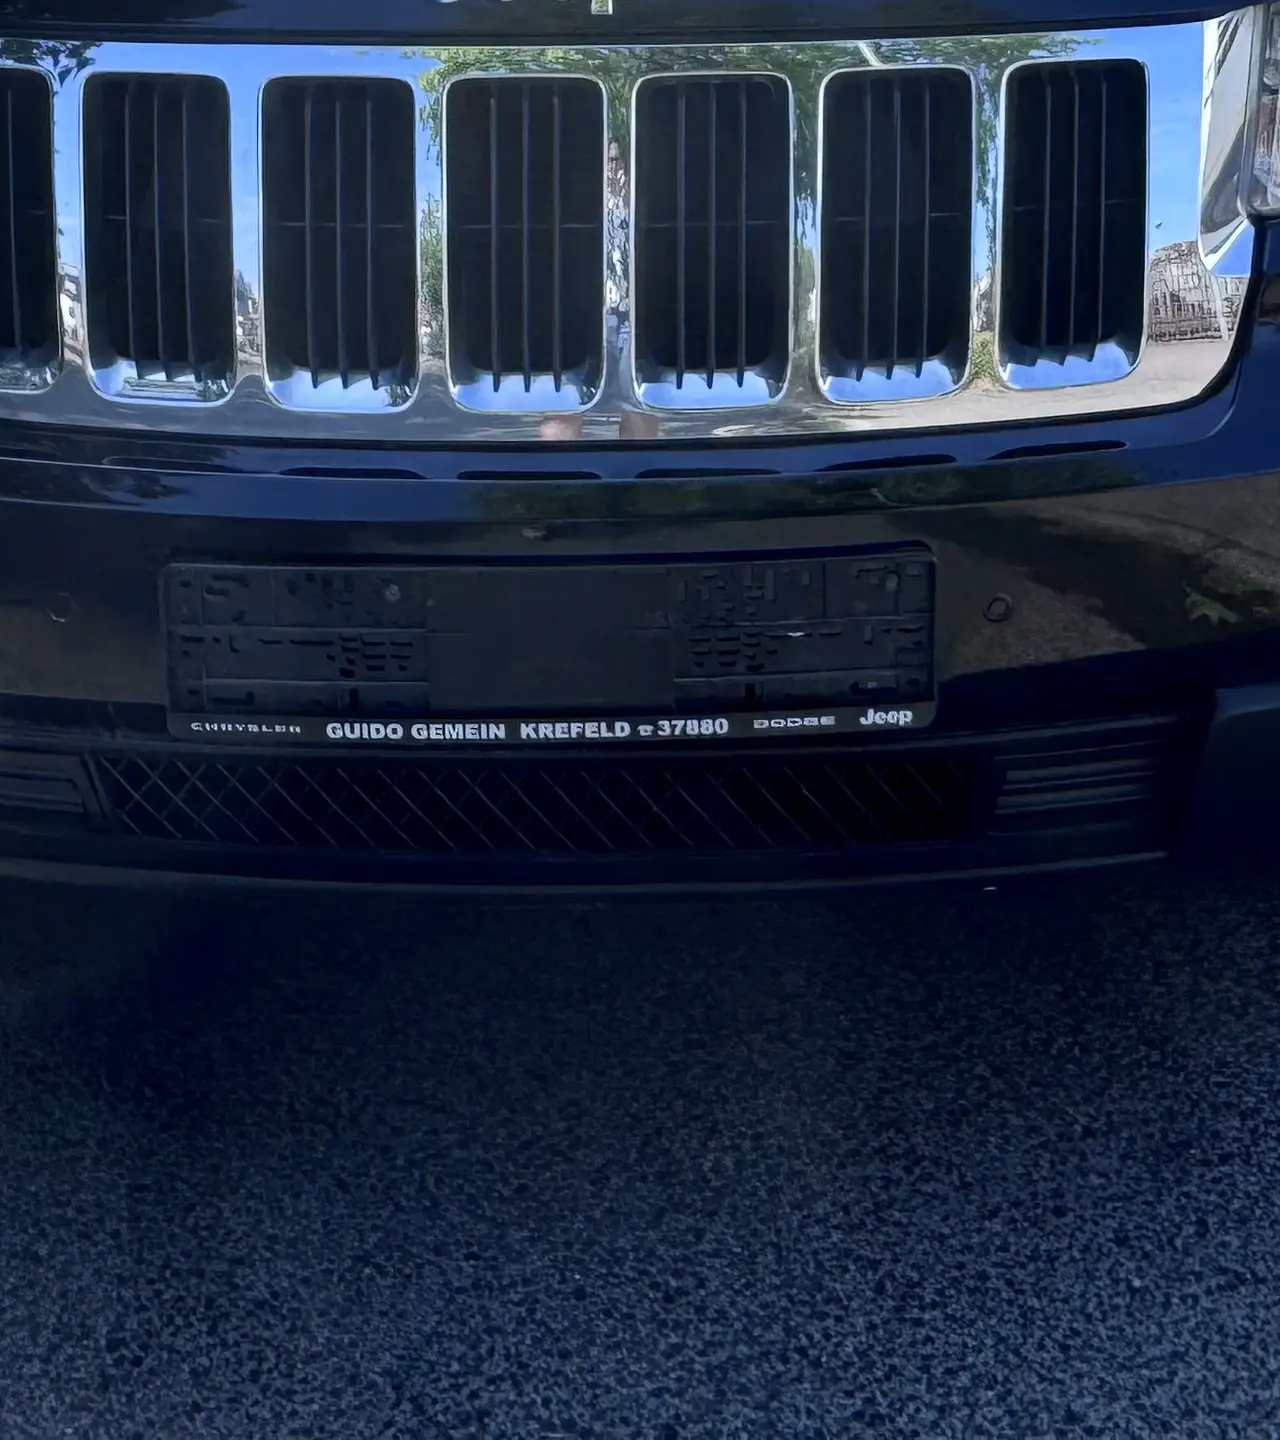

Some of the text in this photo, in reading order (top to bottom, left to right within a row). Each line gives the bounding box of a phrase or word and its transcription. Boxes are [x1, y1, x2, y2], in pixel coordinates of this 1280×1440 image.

[326, 722, 404, 740] GUIDO
[411, 722, 506, 740] GEMEIN
[520, 721, 632, 740] KREFELD
[859, 708, 913, 726] Jeep
